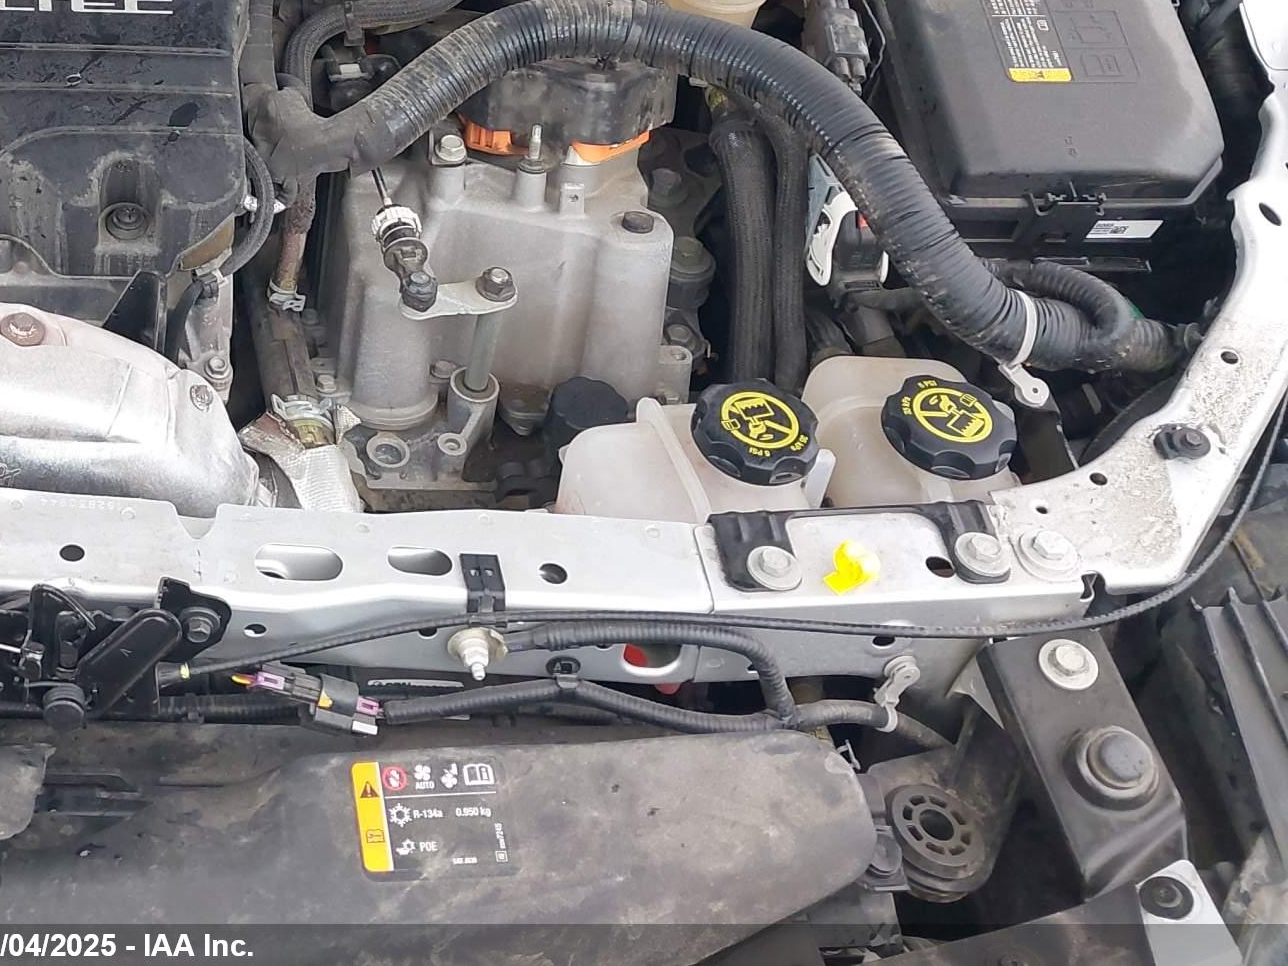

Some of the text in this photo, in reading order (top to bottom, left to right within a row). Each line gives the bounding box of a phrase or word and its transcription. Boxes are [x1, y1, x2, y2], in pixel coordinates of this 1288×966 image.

[415, 780, 435, 790] AUTO
[412, 808, 444, 819] R-134a
[479, 806, 492, 818] kg
[419, 841, 438, 852] POE
